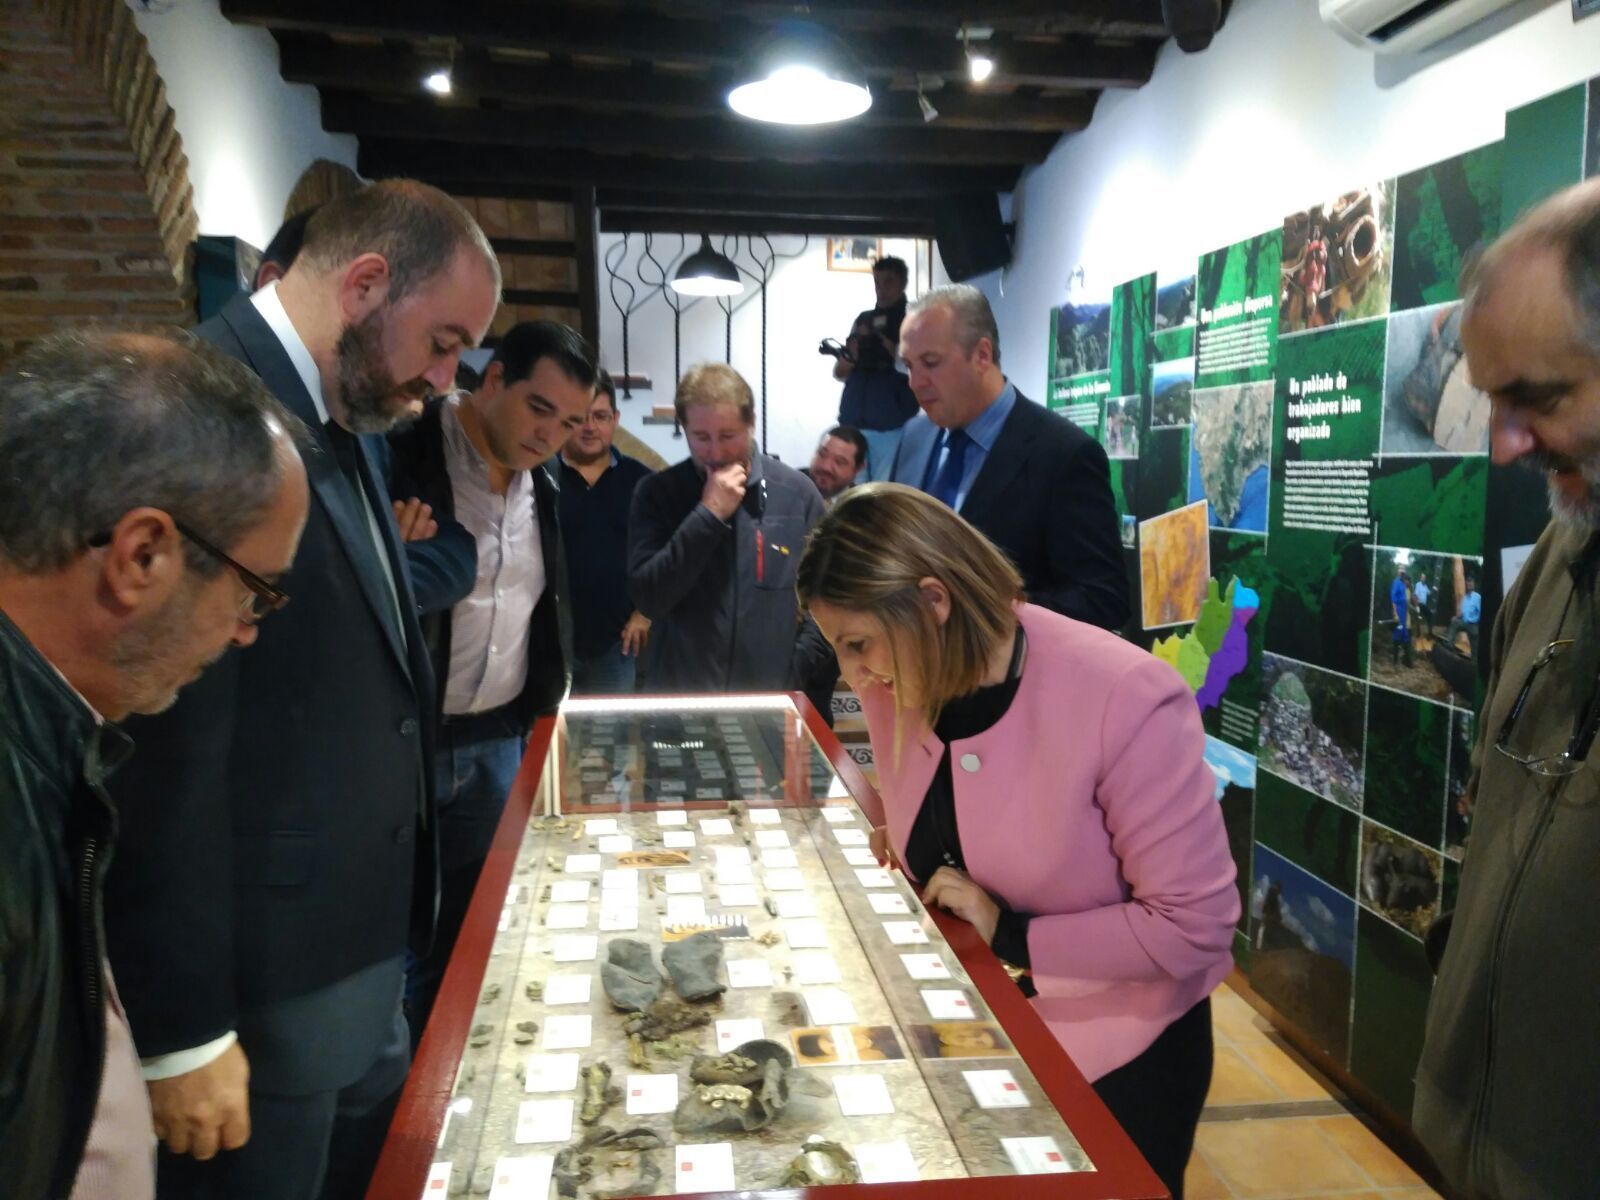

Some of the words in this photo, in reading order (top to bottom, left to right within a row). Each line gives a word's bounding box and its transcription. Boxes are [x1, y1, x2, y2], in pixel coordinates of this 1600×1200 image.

[1289, 377, 1300, 396] Un
[1302, 372, 1334, 399] poblado
[1336, 370, 1347, 391] de
[1288, 397, 1340, 420] trabajadores
[1341, 394, 1362, 415] bien
[1286, 420, 1331, 445] organizado
